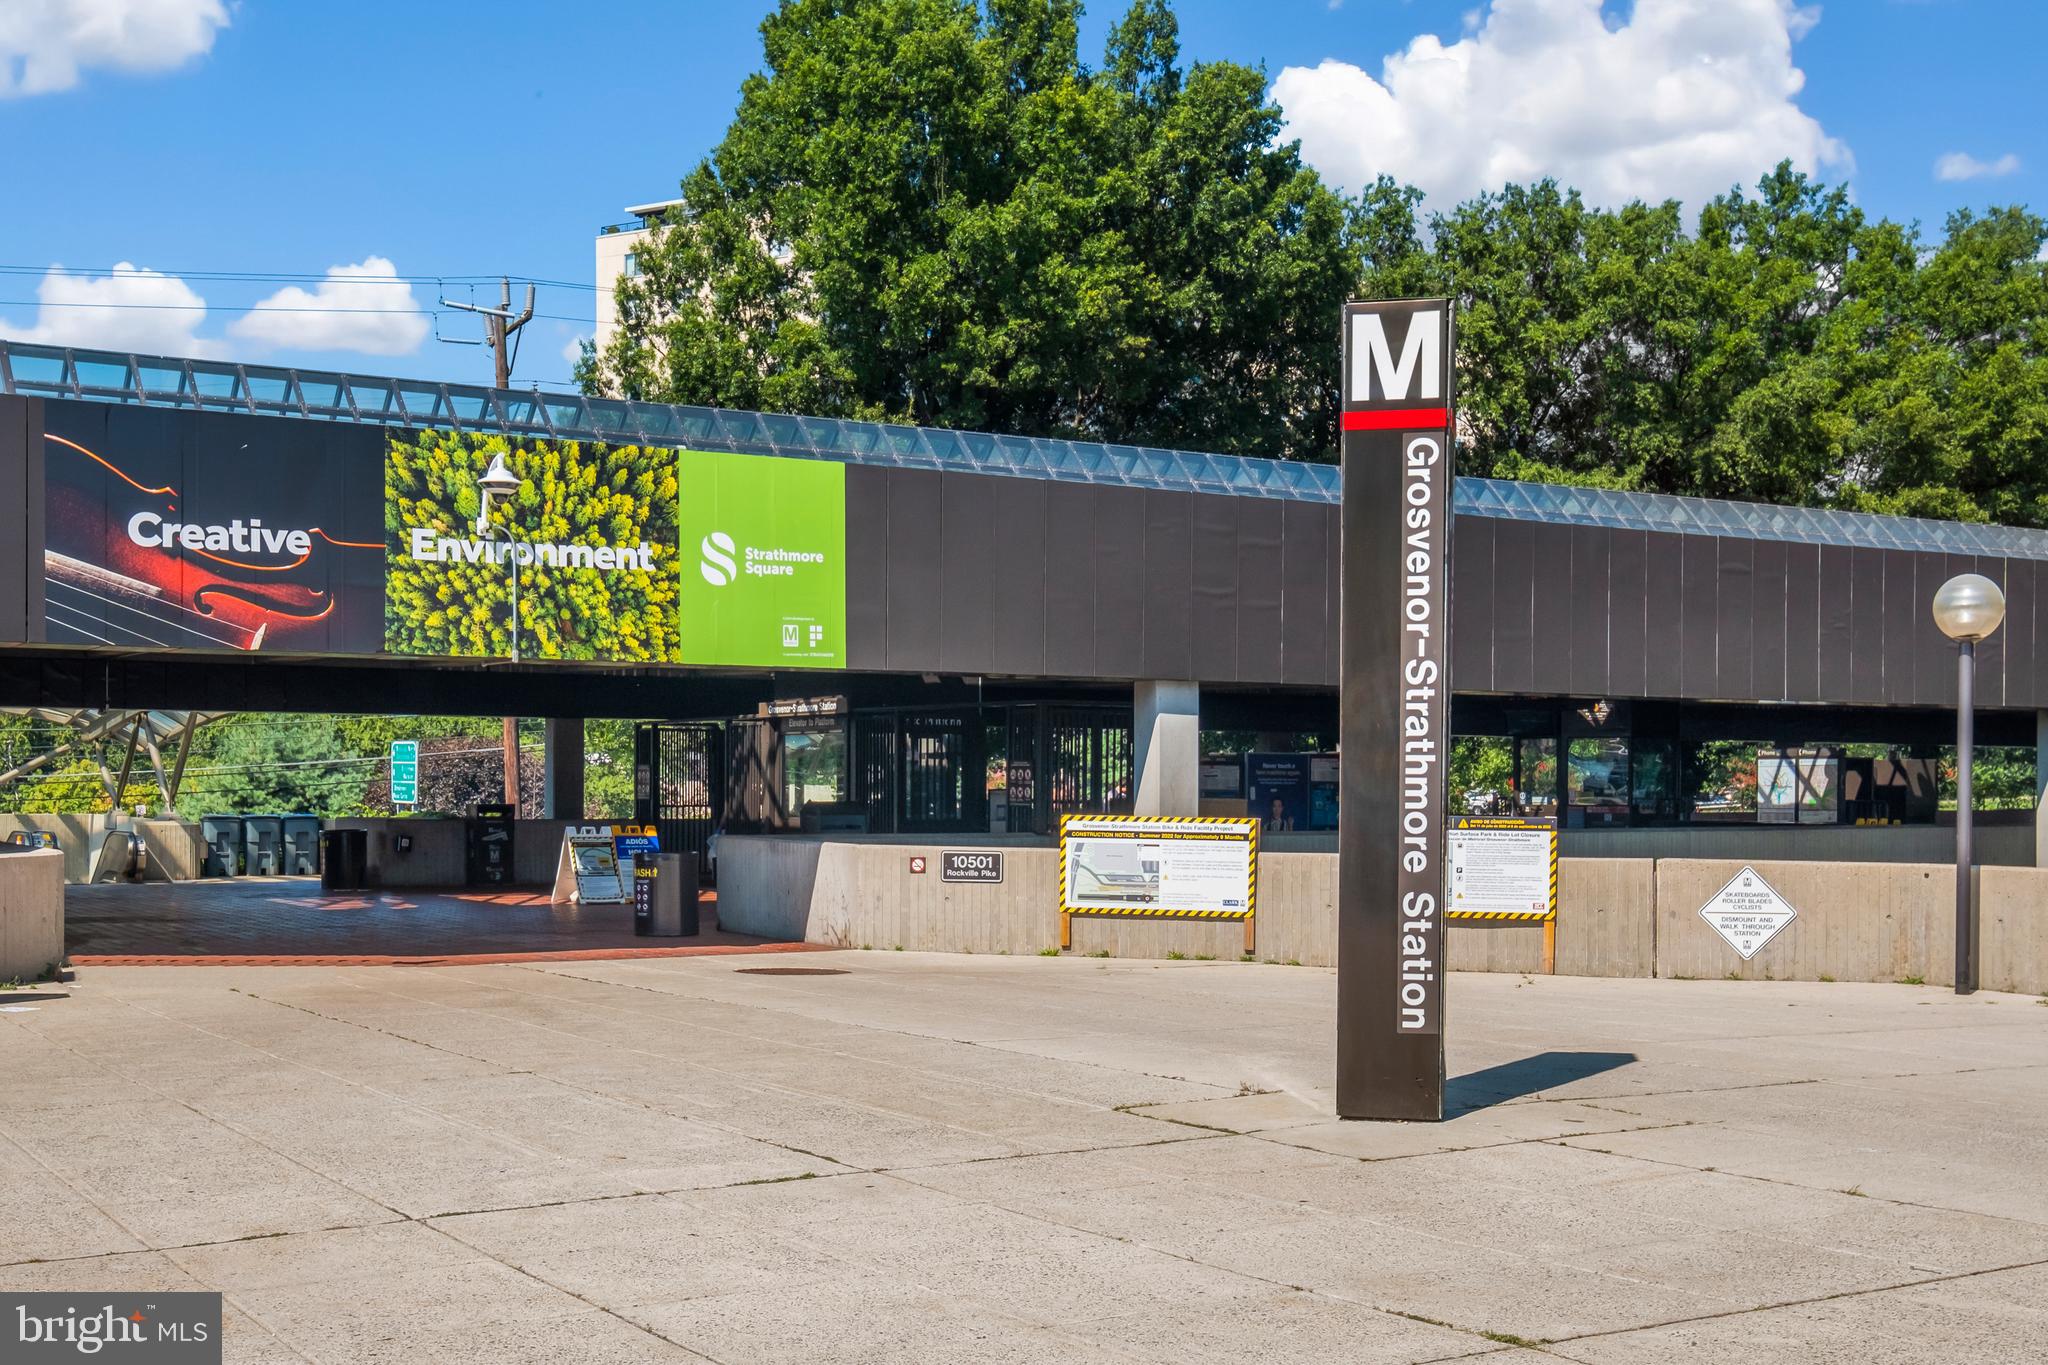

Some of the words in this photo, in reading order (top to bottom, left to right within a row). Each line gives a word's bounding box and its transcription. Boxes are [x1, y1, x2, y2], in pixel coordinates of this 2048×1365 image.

[1351, 310, 1441, 401] M
[127, 511, 311, 555] Creative
[412, 528, 656, 571] Environment
[745, 547, 824, 563] Strathmore
[745, 561, 794, 577] Square
[1402, 437, 1440, 873] Grosvenor-Strathmore
[946, 869, 979, 877] Rockville
[981, 869, 997, 877] Pike
[951, 855, 993, 869] 10501
[1401, 892, 1435, 1029] Station
